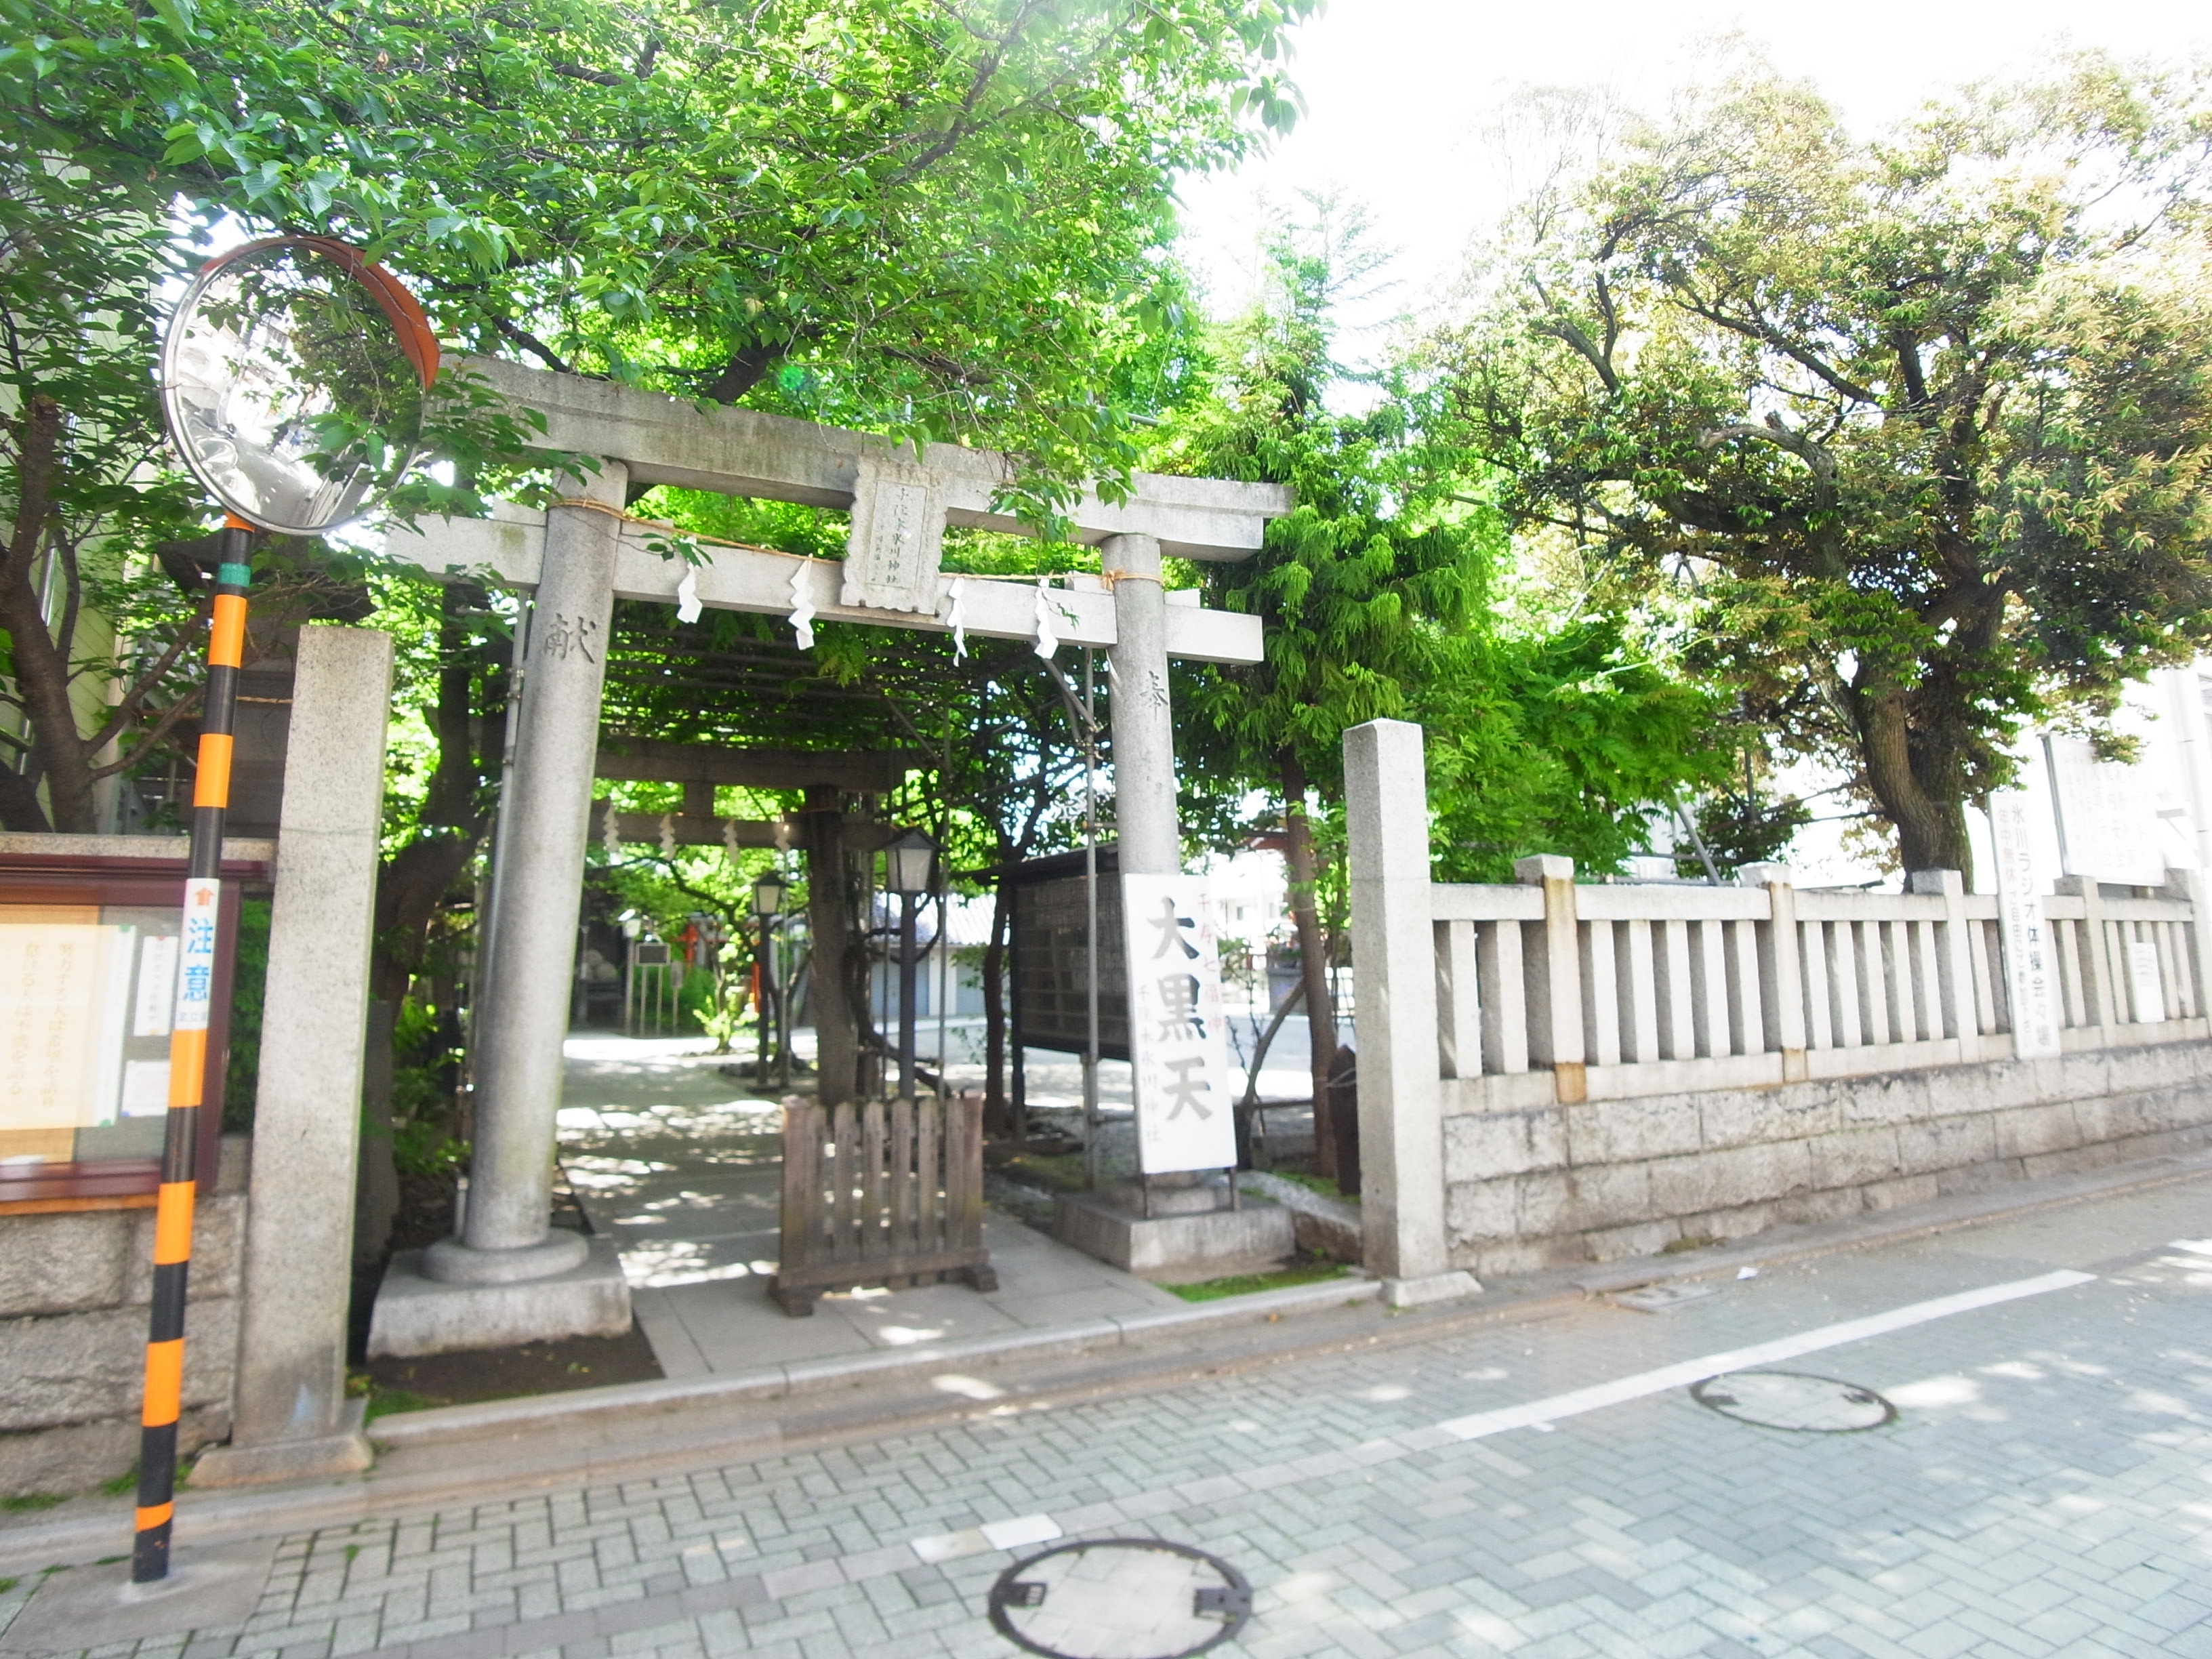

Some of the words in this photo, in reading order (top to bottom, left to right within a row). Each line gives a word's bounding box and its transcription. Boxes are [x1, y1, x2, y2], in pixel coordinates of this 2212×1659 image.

[1139, 670, 1168, 722] 奉
[183, 918, 213, 1002] 注意
[1147, 897, 1212, 1120] 大黒天
